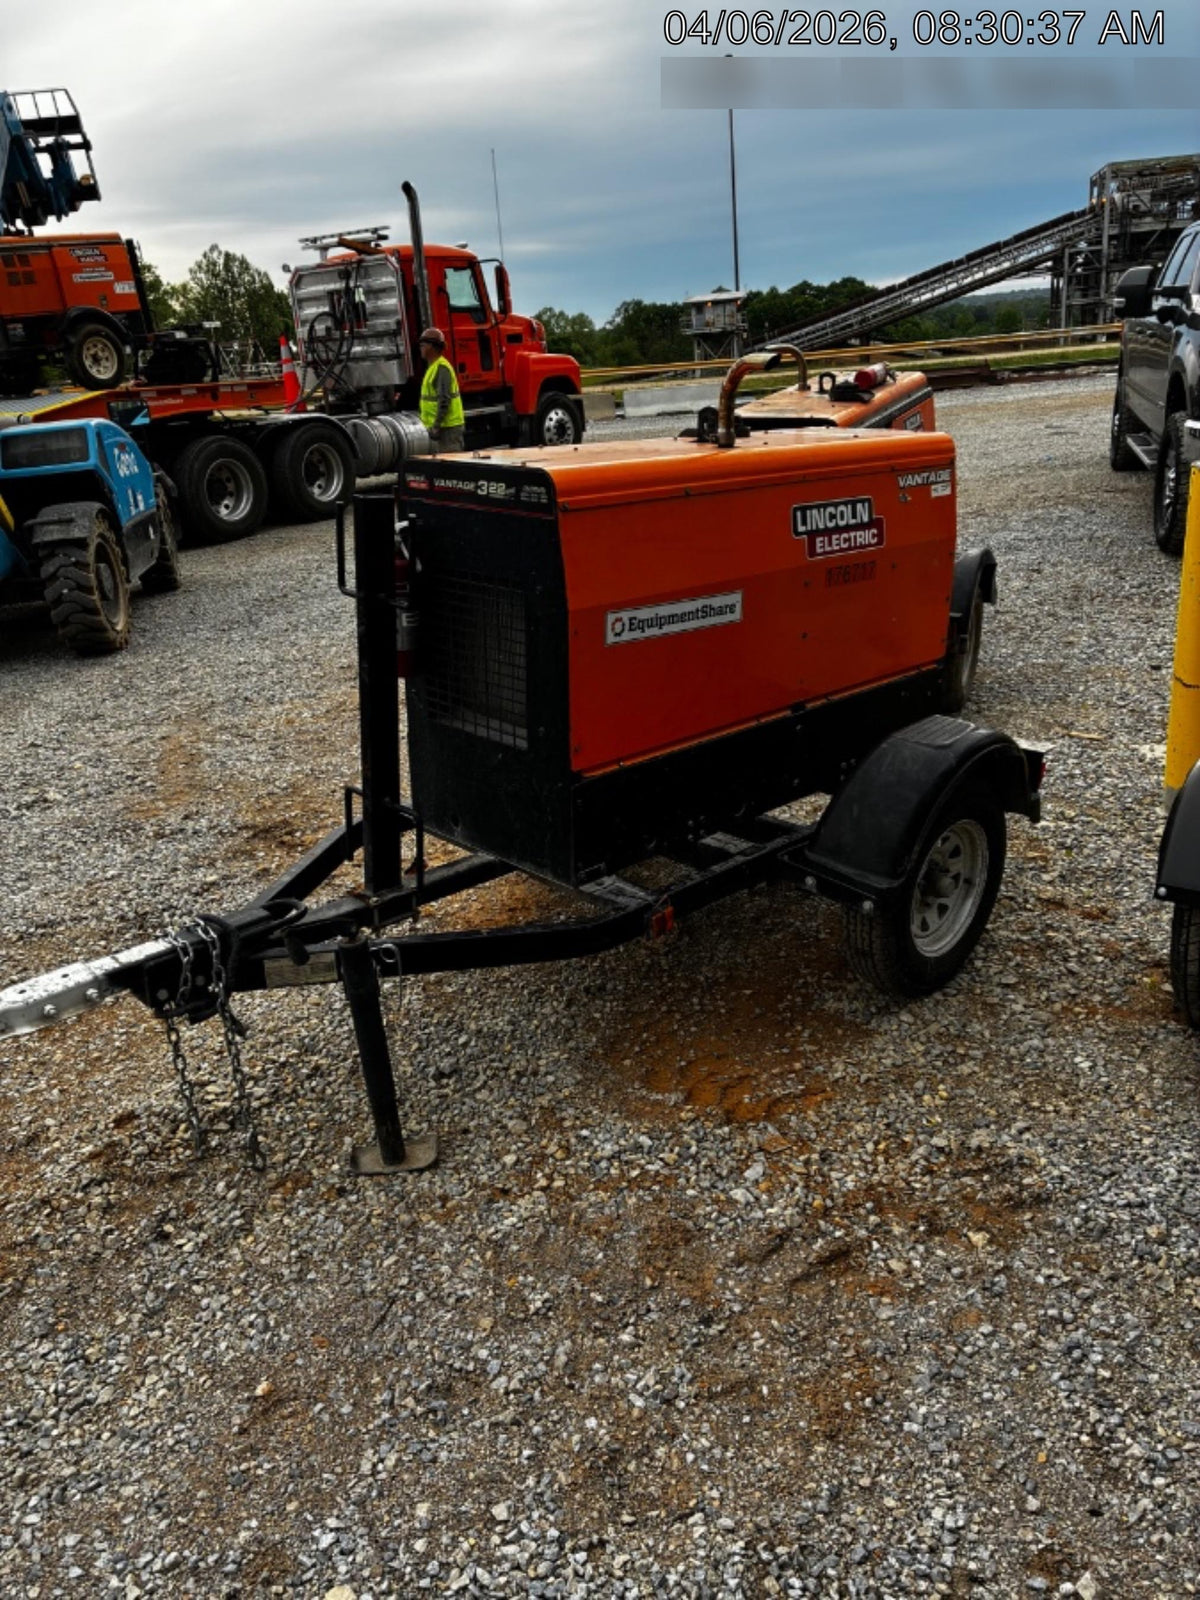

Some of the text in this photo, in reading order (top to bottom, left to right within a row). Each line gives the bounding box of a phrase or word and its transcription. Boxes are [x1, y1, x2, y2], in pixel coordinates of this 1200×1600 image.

[433, 478, 476, 491] VANTAGE
[477, 480, 506, 496] 322
[898, 469, 951, 488] VANTAGE
[795, 502, 869, 532] LINCOLN
[815, 528, 878, 553] ELECTRIC
[628, 603, 737, 633] EquipmentShare
